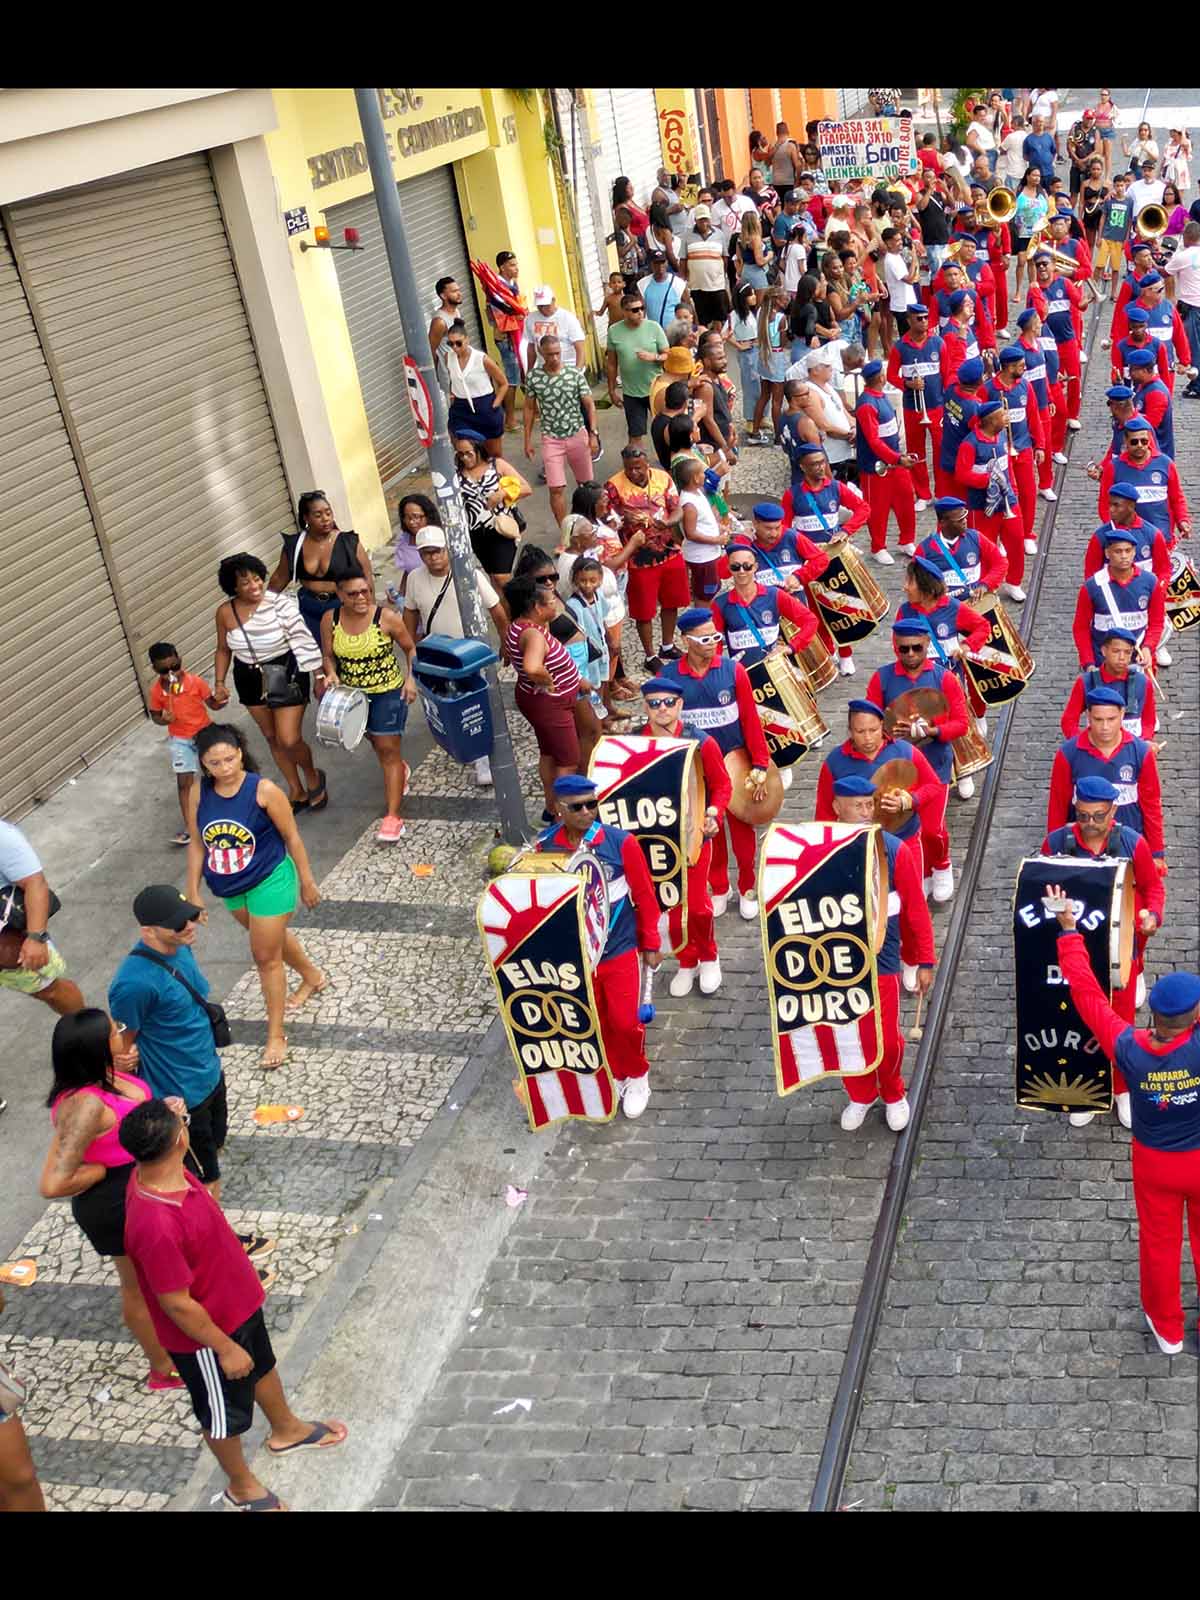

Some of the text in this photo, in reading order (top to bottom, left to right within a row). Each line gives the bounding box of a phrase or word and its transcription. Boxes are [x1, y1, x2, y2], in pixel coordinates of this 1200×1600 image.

[821, 145, 855, 156] AMSTEL
[825, 166, 873, 179] HEINEKEN
[598, 797, 677, 831] ELOS
[778, 893, 864, 935] ELOS
[501, 959, 581, 991] ELOS
[778, 987, 871, 1022] OURO
[521, 1040, 600, 1069] OURO
[1024, 1028, 1101, 1054] OURO
[1140, 1076, 1200, 1091] ELOS DE OURO
[1147, 1069, 1191, 1081] FANFARRA
